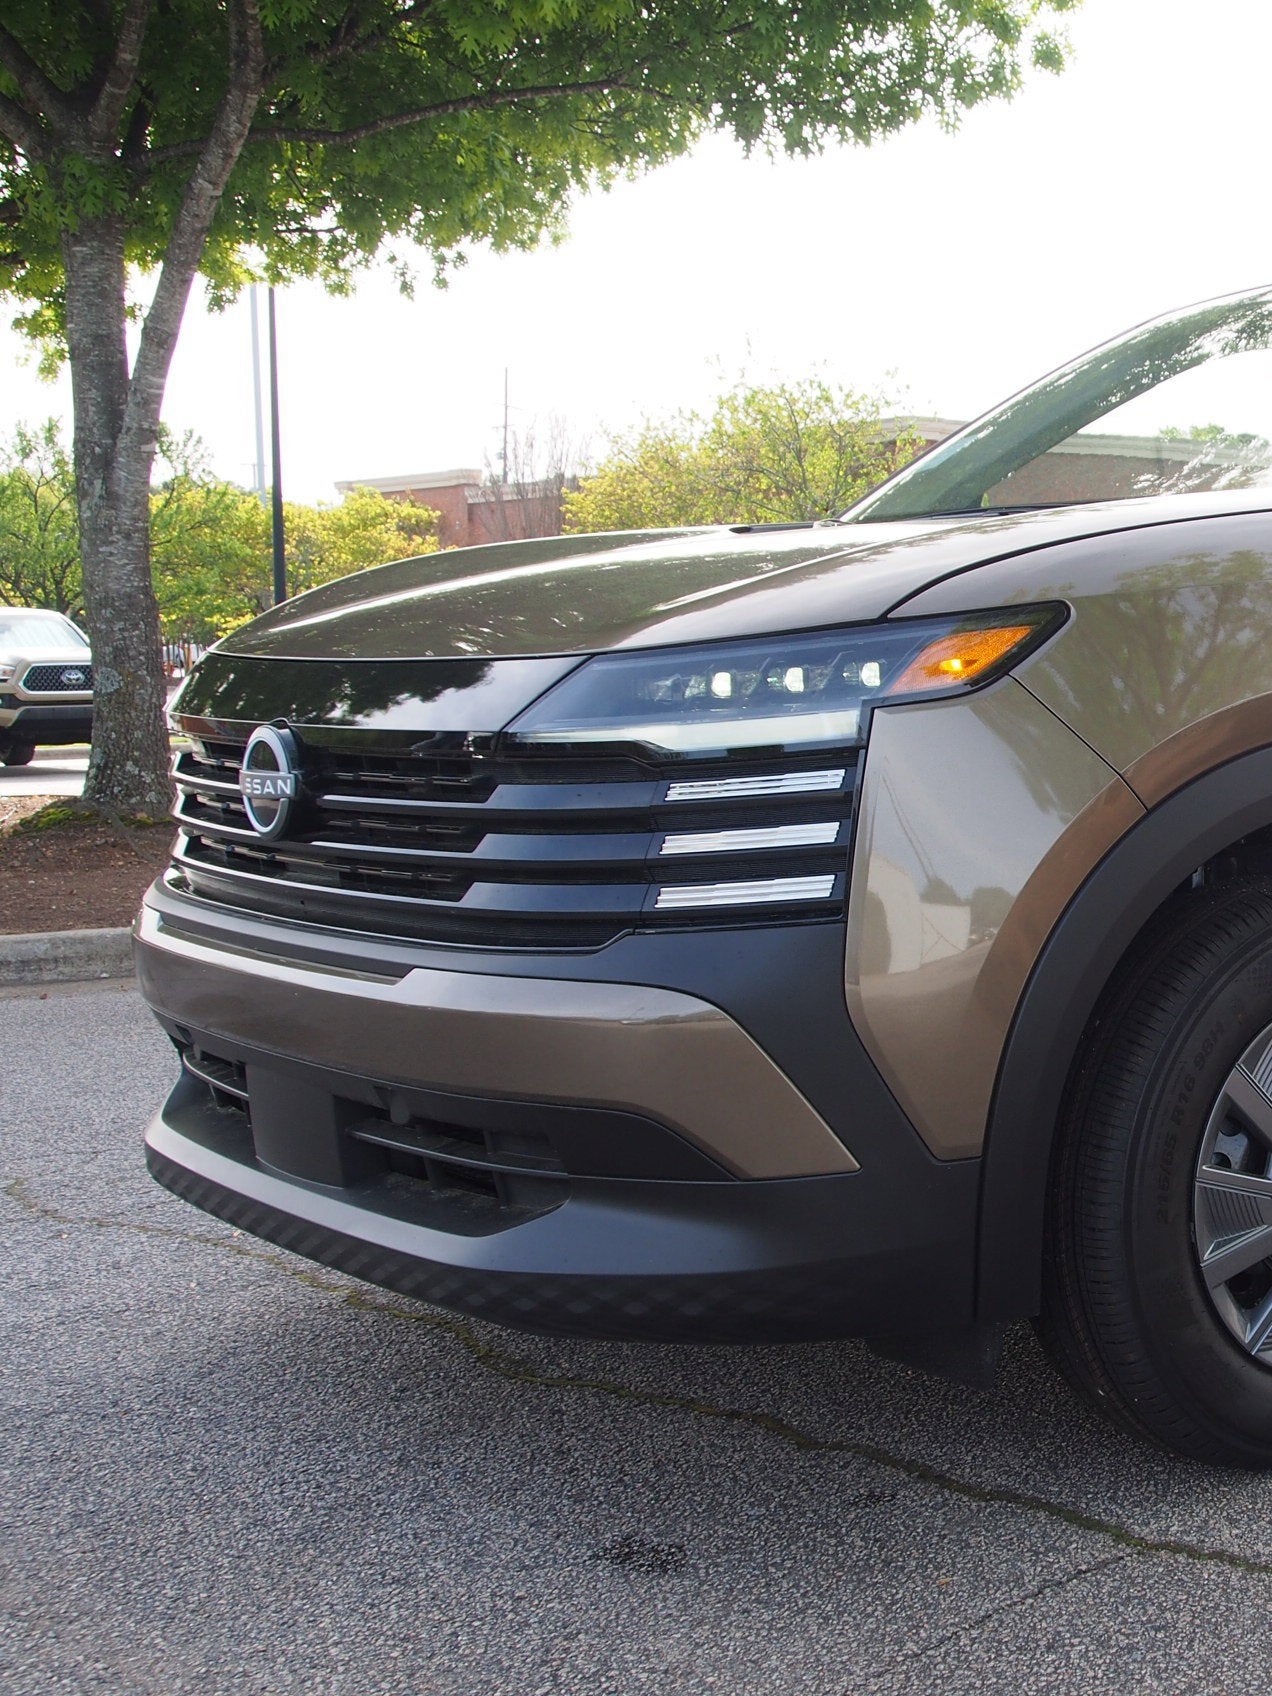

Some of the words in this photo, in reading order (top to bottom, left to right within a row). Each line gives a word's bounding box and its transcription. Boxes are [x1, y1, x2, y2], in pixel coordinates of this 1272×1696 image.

[245, 777, 291, 795] SSAN
[1156, 1131, 1177, 1225] 215/65
[1170, 1074, 1196, 1126] R16
